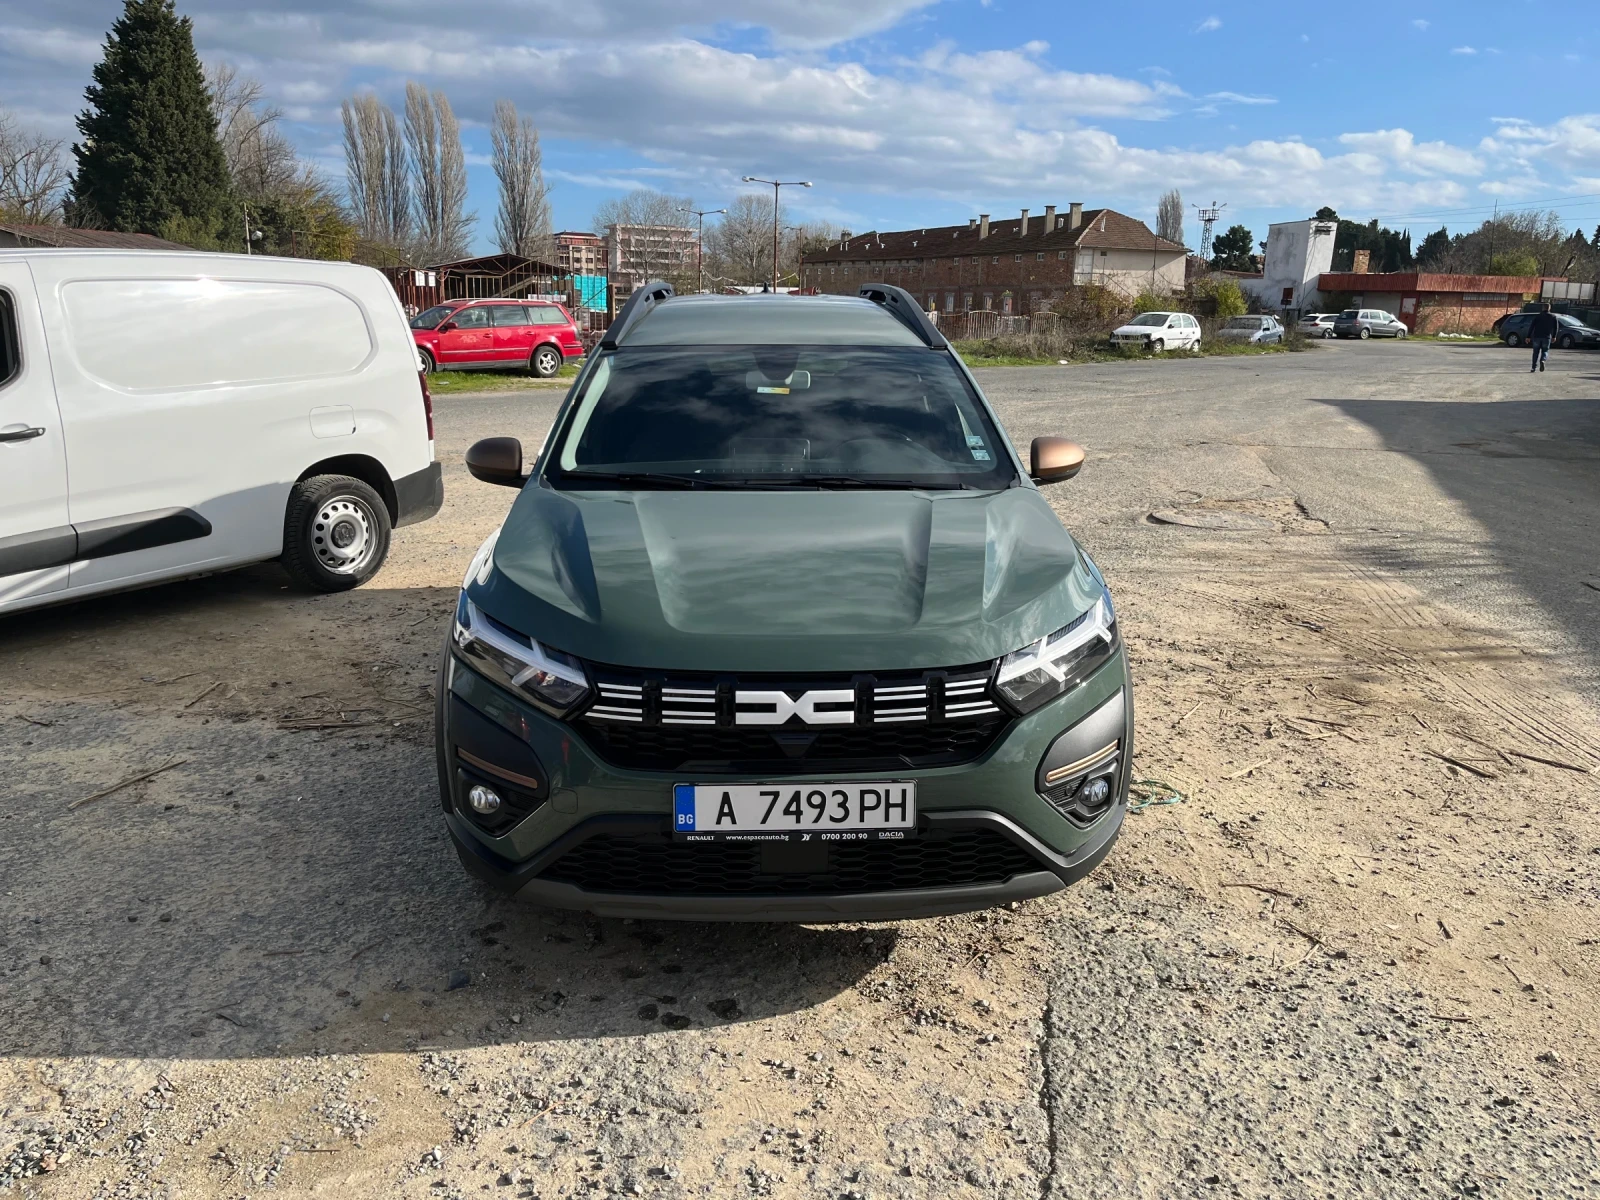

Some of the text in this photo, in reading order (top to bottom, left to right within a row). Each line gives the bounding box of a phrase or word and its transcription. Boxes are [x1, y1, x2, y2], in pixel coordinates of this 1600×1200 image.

[715, 791, 737, 825] A
[678, 813, 694, 825] BG
[726, 834, 789, 842] www.espaceauto.bg
[858, 832, 868, 840] 90
